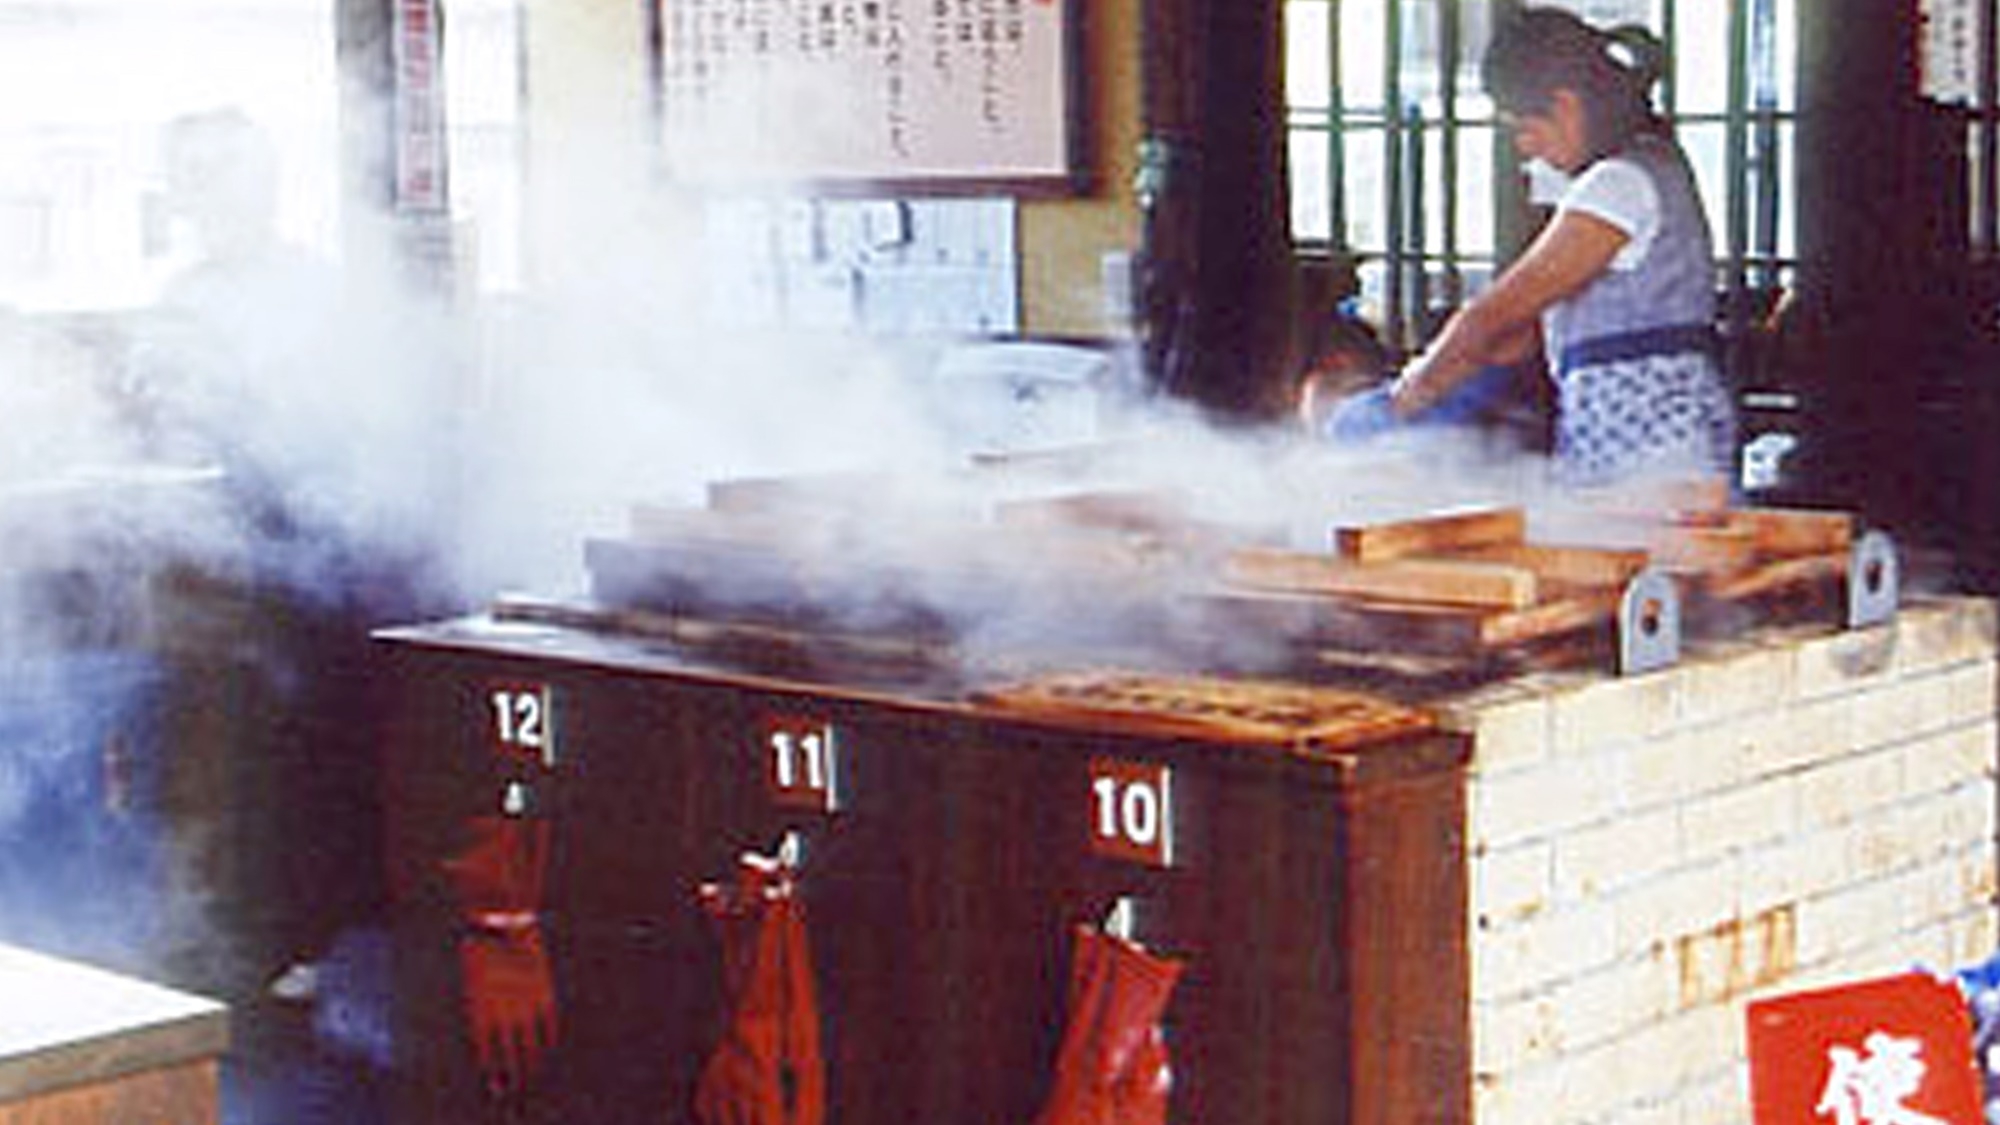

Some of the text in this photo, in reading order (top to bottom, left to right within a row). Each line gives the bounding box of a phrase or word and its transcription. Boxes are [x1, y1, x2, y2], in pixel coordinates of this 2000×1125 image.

[494, 692, 541, 746] 12
[771, 732, 822, 790] 11
[1094, 777, 1156, 843] 10
